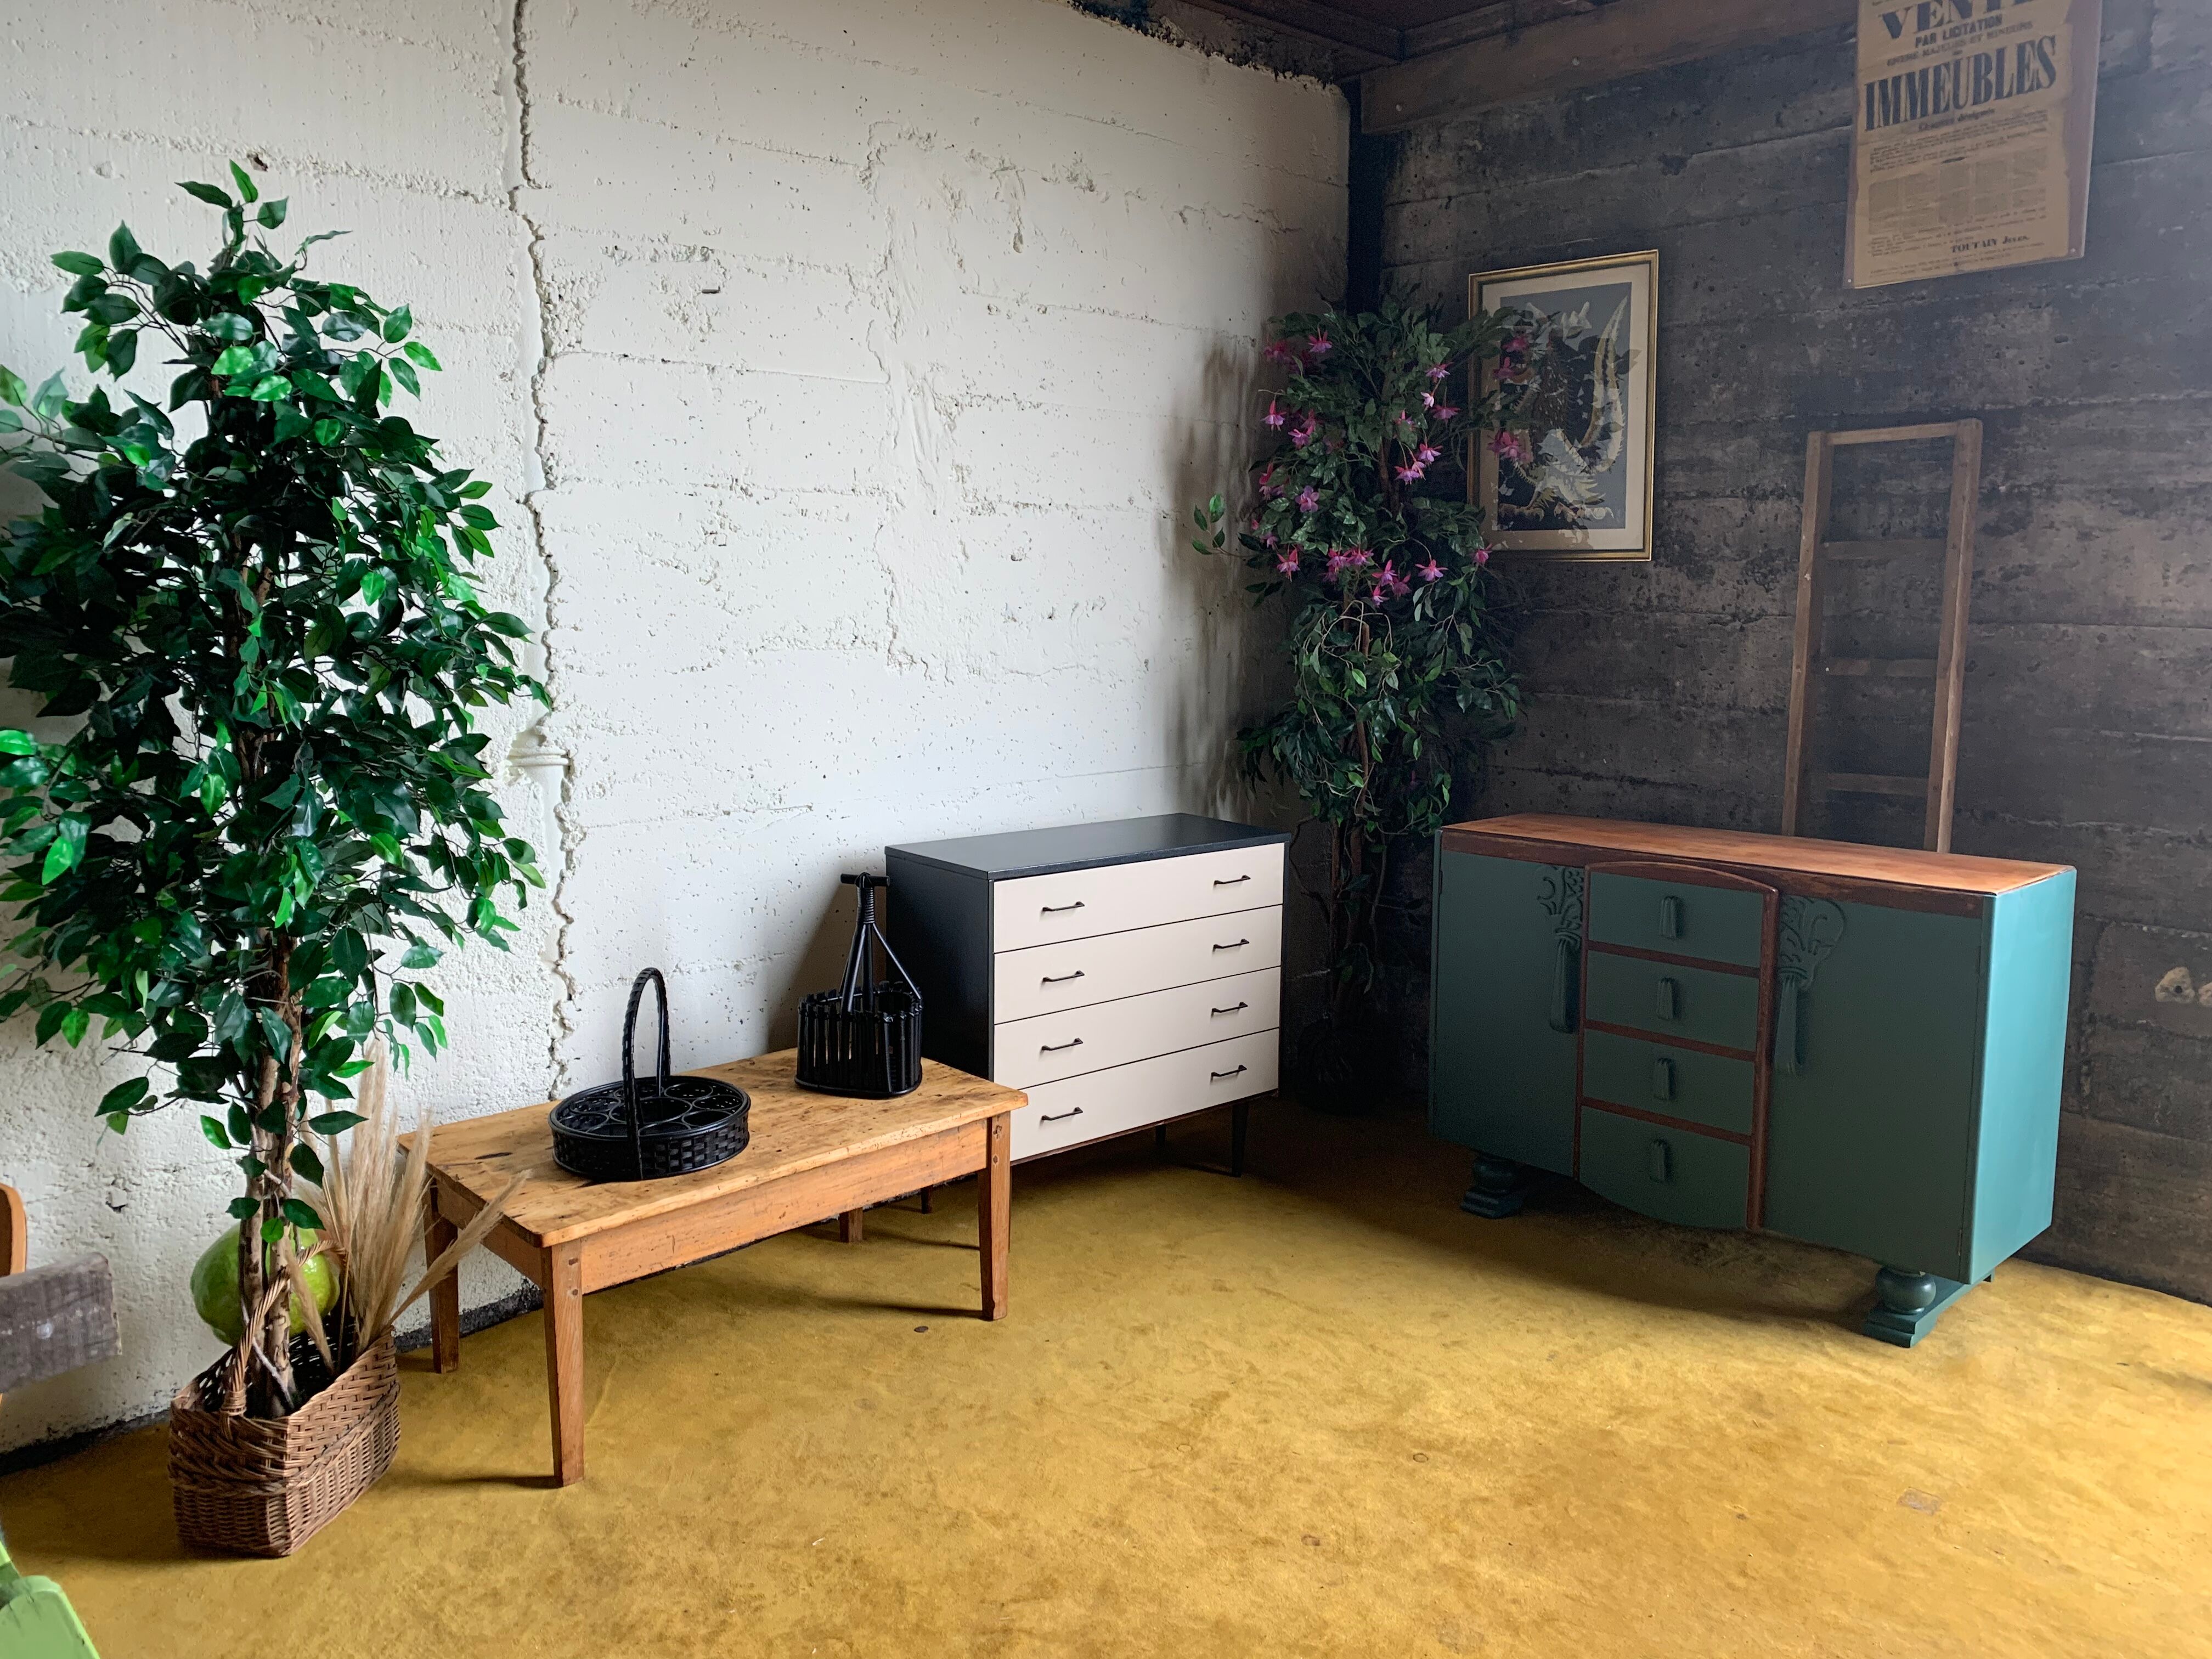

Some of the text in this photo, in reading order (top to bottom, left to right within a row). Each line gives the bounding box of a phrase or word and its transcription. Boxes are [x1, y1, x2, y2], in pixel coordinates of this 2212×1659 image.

[1878, 0, 2033, 40] VEN
[1915, 14, 2003, 48] PAR LICITATION
[1864, 35, 2057, 132] IMMEUBLES
